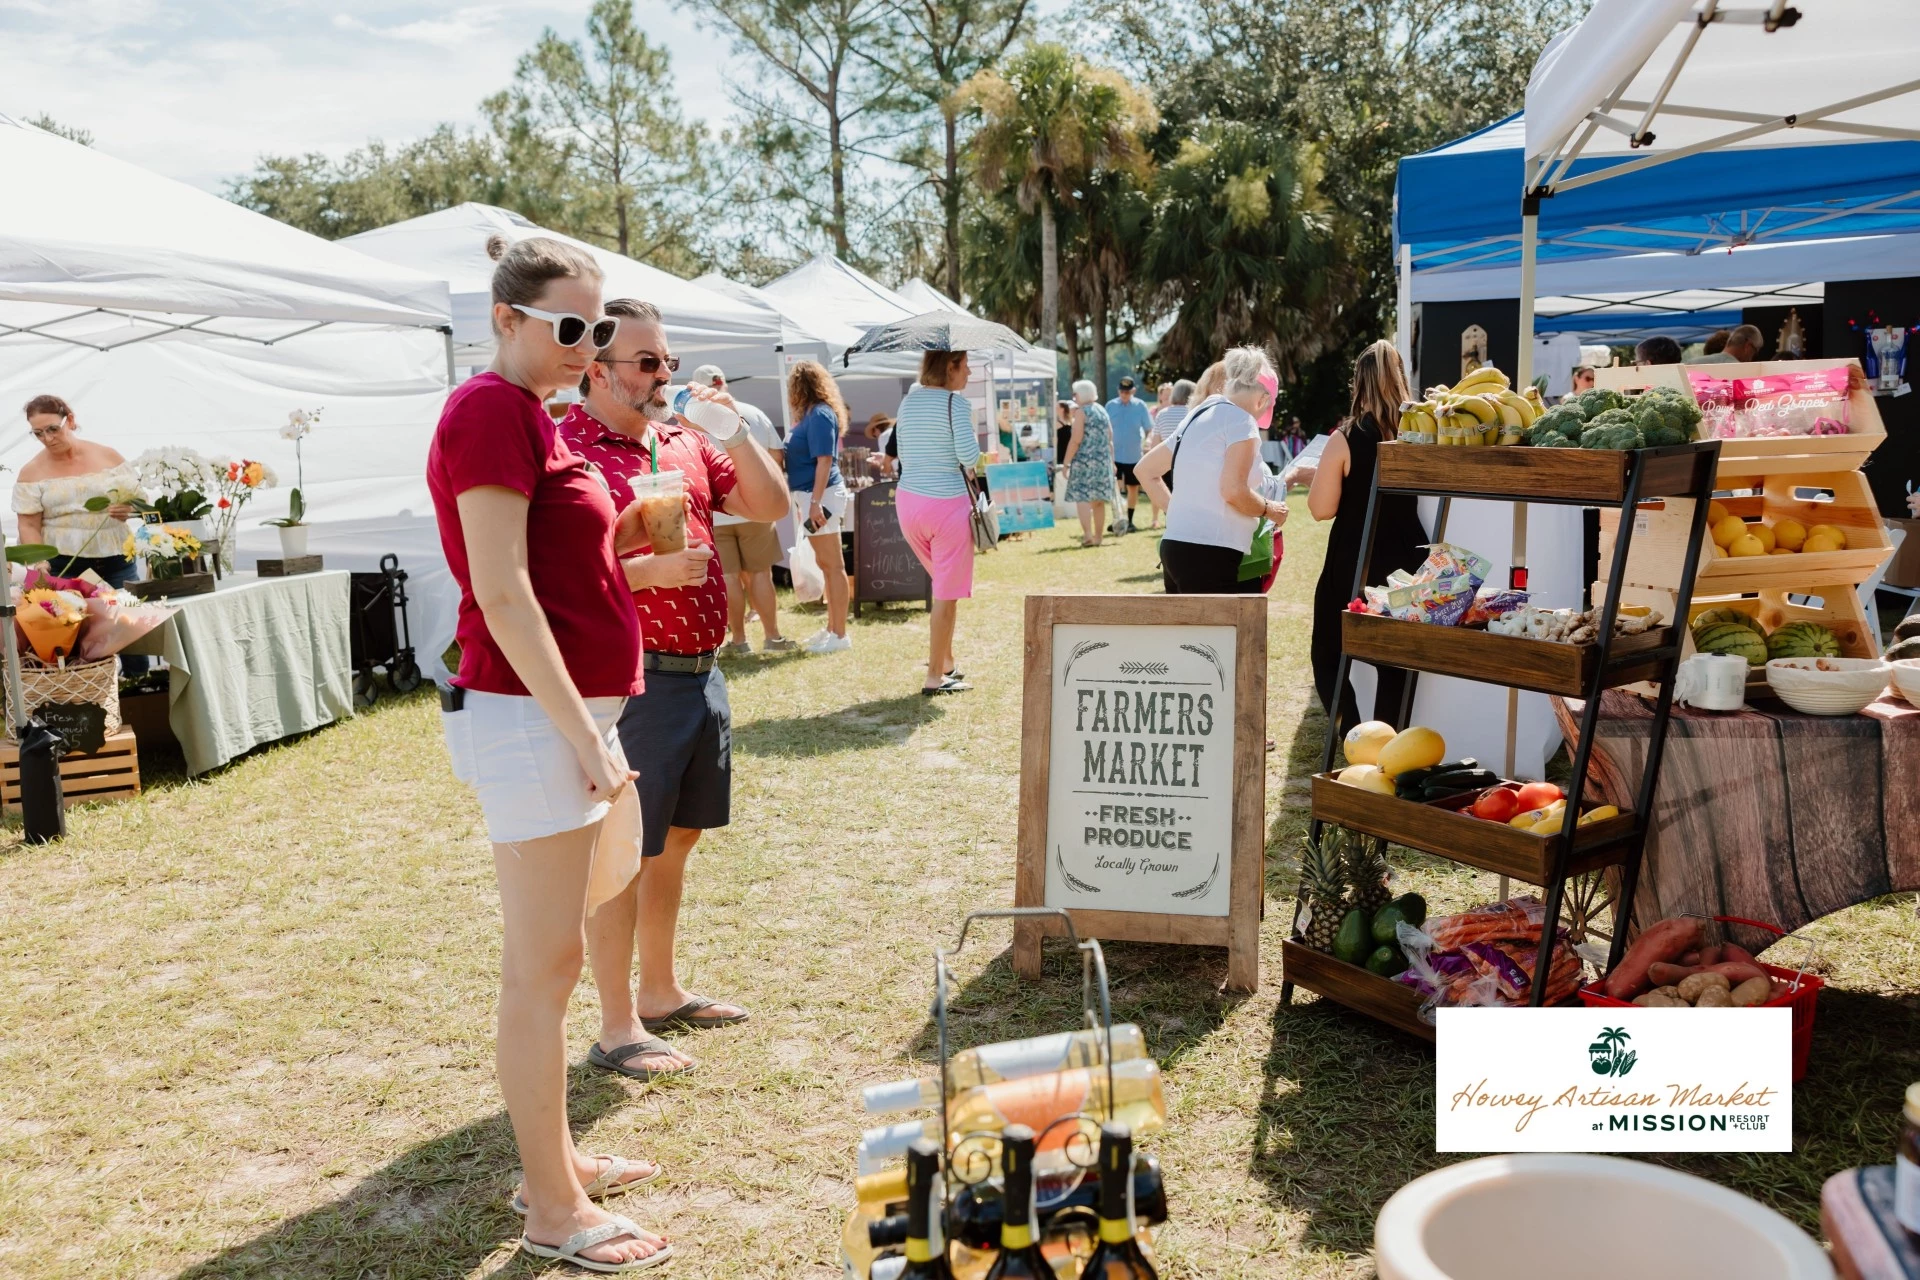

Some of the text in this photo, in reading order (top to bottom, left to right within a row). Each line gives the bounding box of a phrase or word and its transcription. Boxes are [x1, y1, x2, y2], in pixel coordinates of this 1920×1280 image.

[1744, 393, 1829, 417] Red Grapes
[44, 711, 74, 723] Fresh
[1076, 689, 1214, 736] FARMERS
[1083, 740, 1204, 788] MARKET
[1099, 805, 1176, 826] FRESH
[1084, 826, 1192, 851] PRODUCE
[1094, 854, 1179, 875] Locally Grown
